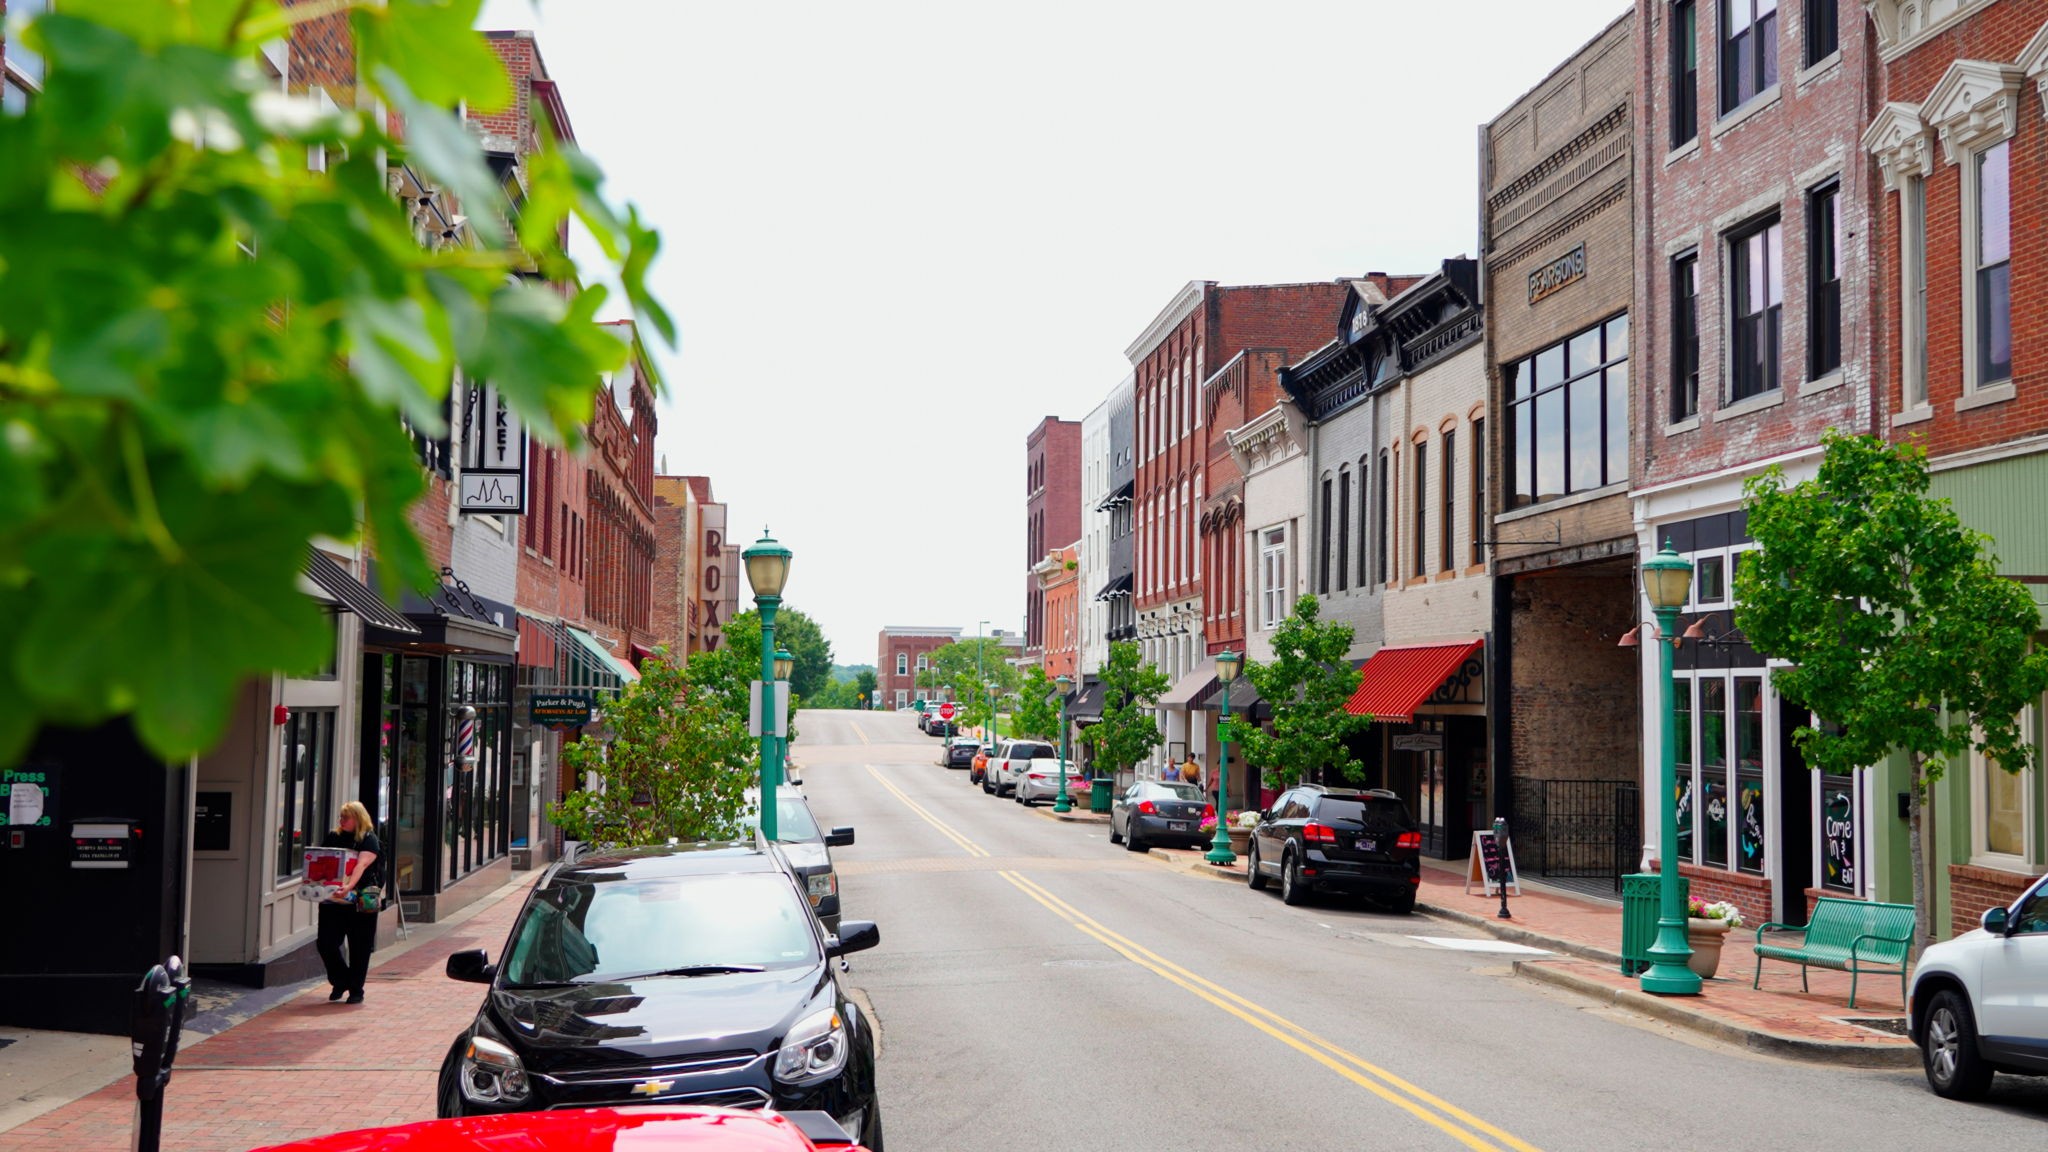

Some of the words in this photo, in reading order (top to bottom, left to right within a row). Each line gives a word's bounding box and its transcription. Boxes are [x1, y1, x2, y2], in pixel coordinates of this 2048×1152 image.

[1530, 250, 1584, 299] PEARSONS
[496, 386, 507, 461] RKET
[704, 530, 721, 652] ROXY
[536, 699, 559, 707] Parker
[568, 699, 586, 709] Pugh
[4, 769, 45, 783] Press
[1826, 816, 1852, 838] Come
[1842, 868, 1853, 884] EAT
